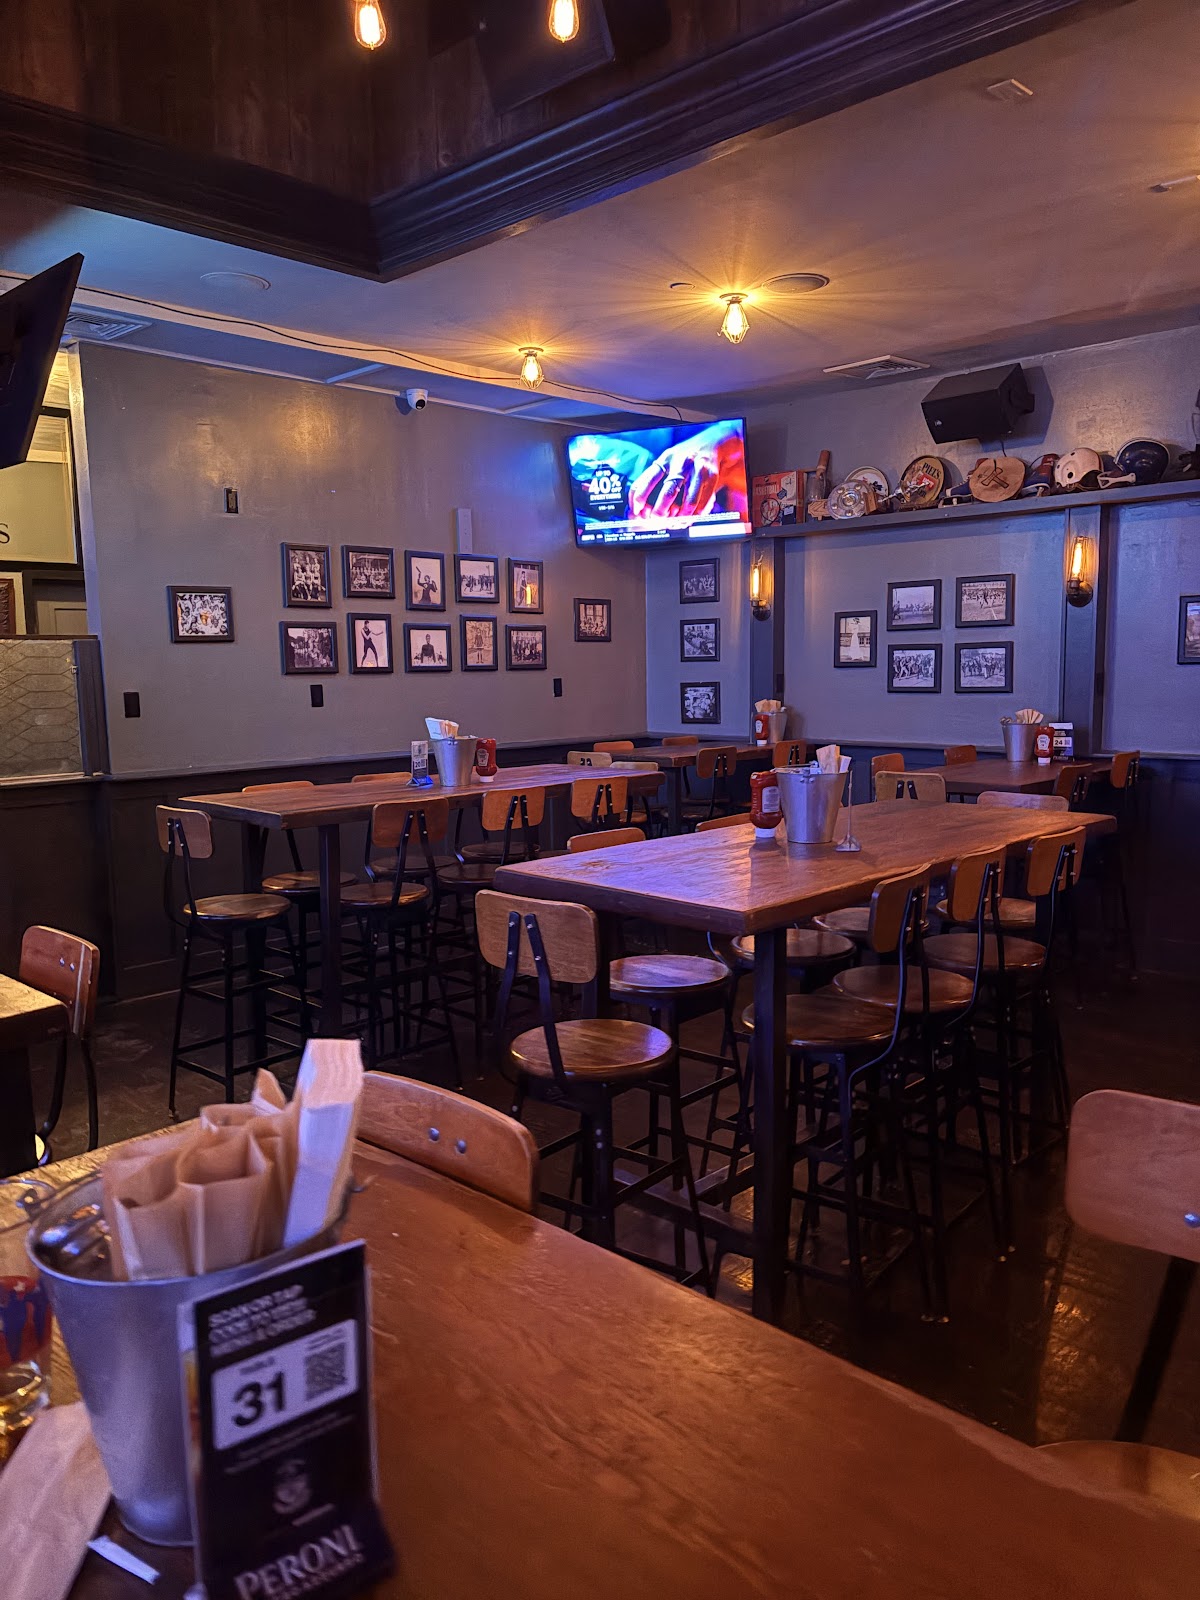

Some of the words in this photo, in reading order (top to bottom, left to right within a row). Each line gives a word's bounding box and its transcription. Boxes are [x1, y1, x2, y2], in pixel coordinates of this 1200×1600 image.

[588, 474, 622, 494] 40%
[231, 1371, 286, 1428] 31
[234, 1523, 358, 1600] PERONI
